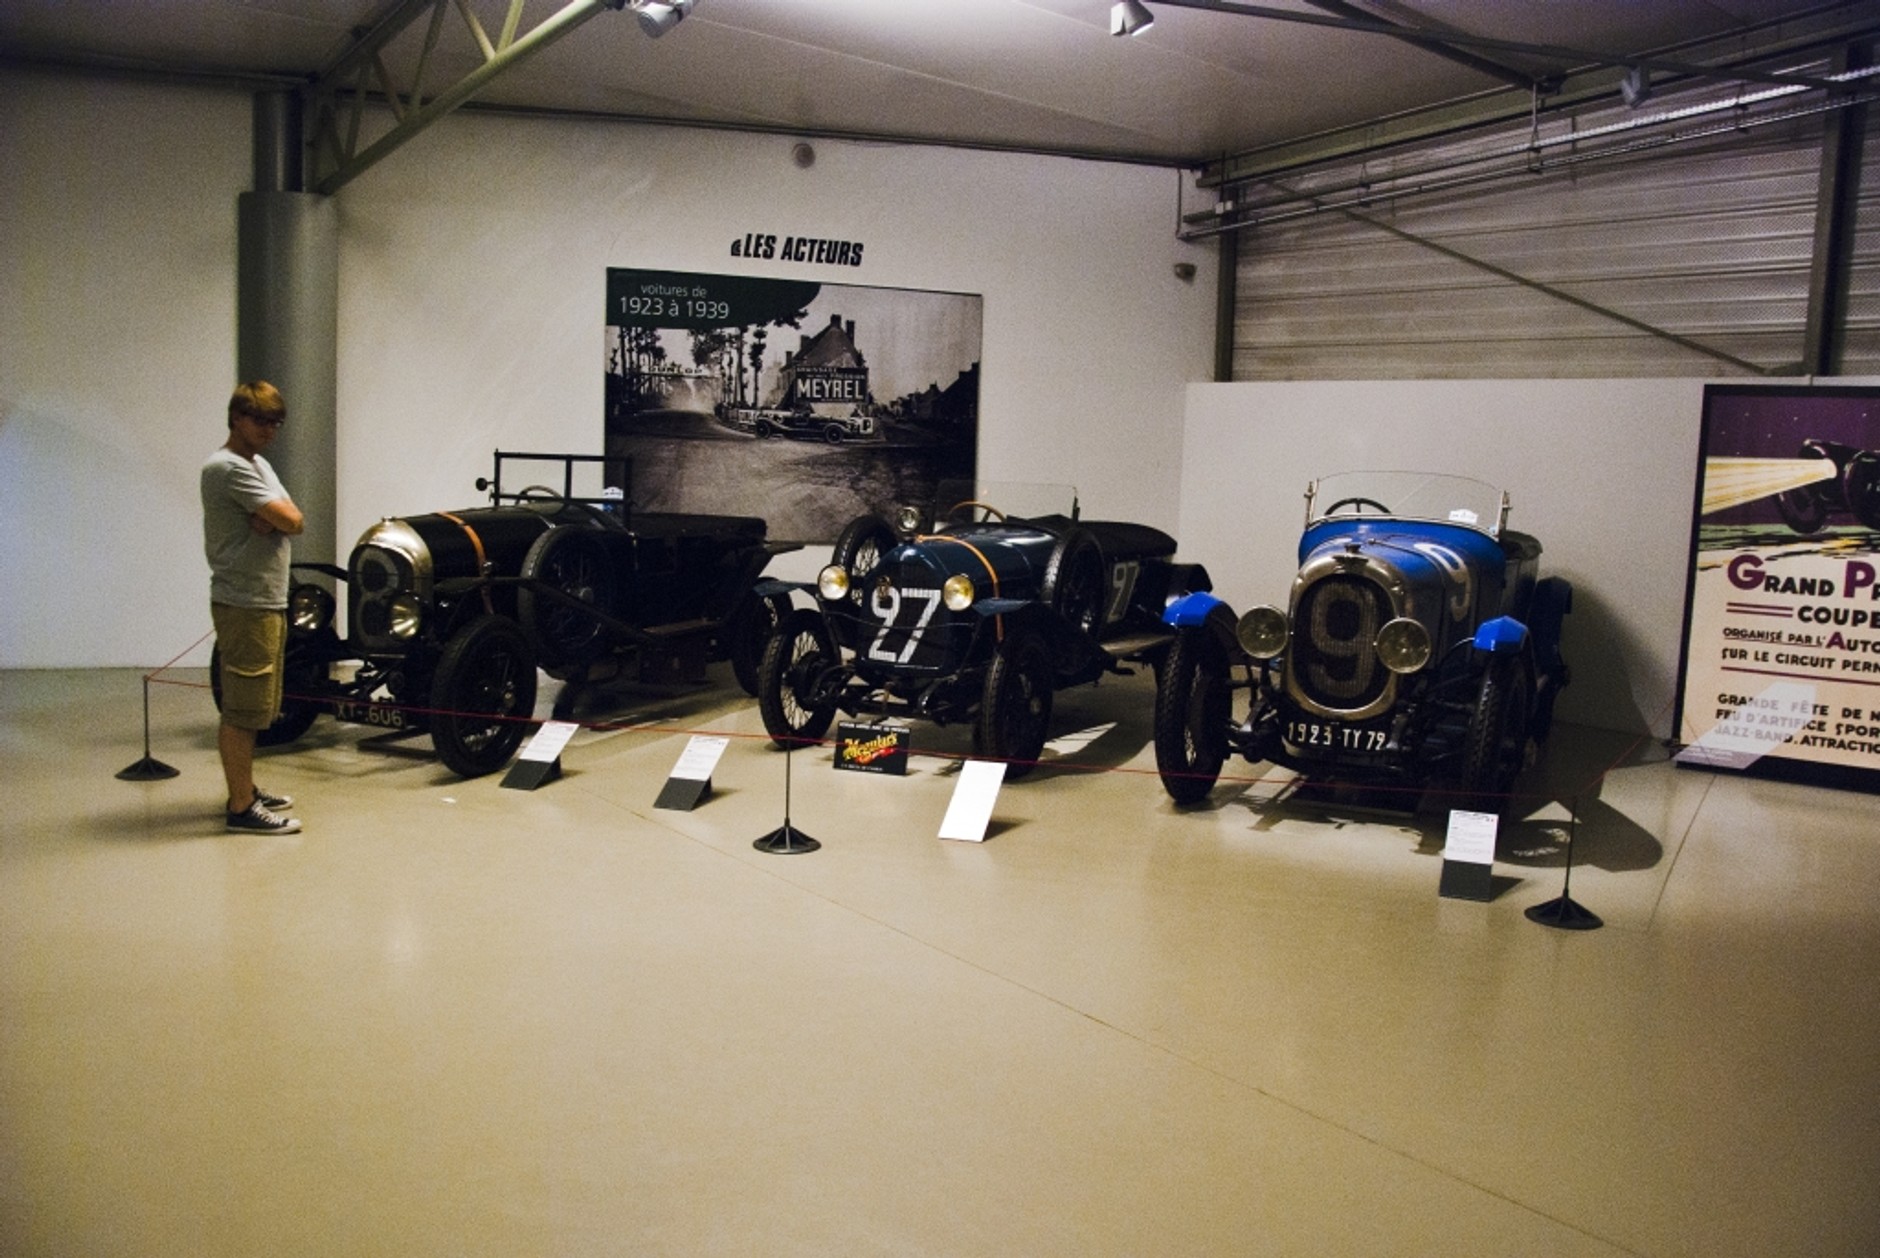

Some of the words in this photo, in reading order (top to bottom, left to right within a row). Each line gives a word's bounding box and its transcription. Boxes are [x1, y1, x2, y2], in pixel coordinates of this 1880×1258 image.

[743, 233, 777, 259] LES
[780, 236, 864, 267] ACTEURS
[641, 283, 688, 297] voitures
[692, 285, 707, 298] de
[620, 296, 664, 315] 1923
[668, 299, 679, 317] à
[686, 300, 730, 319] 1939
[796, 378, 864, 399] MEYREL
[868, 585, 942, 664] 97
[1722, 626, 1783, 642] ORGANISÉ
[1787, 633, 1813, 645] PAR
[1309, 581, 1380, 700] 9
[1721, 648, 1748, 661] SUR
[1753, 650, 1770, 663] LE
[1775, 653, 1836, 669] CIRCUIT
[1715, 708, 1742, 721] FEU
[1717, 693, 1779, 711] GRANDE
[1791, 699, 1830, 716] FÊTE
[1841, 707, 1863, 720] DE
[1288, 721, 1333, 746] 1923
[1342, 728, 1362, 749] TY
